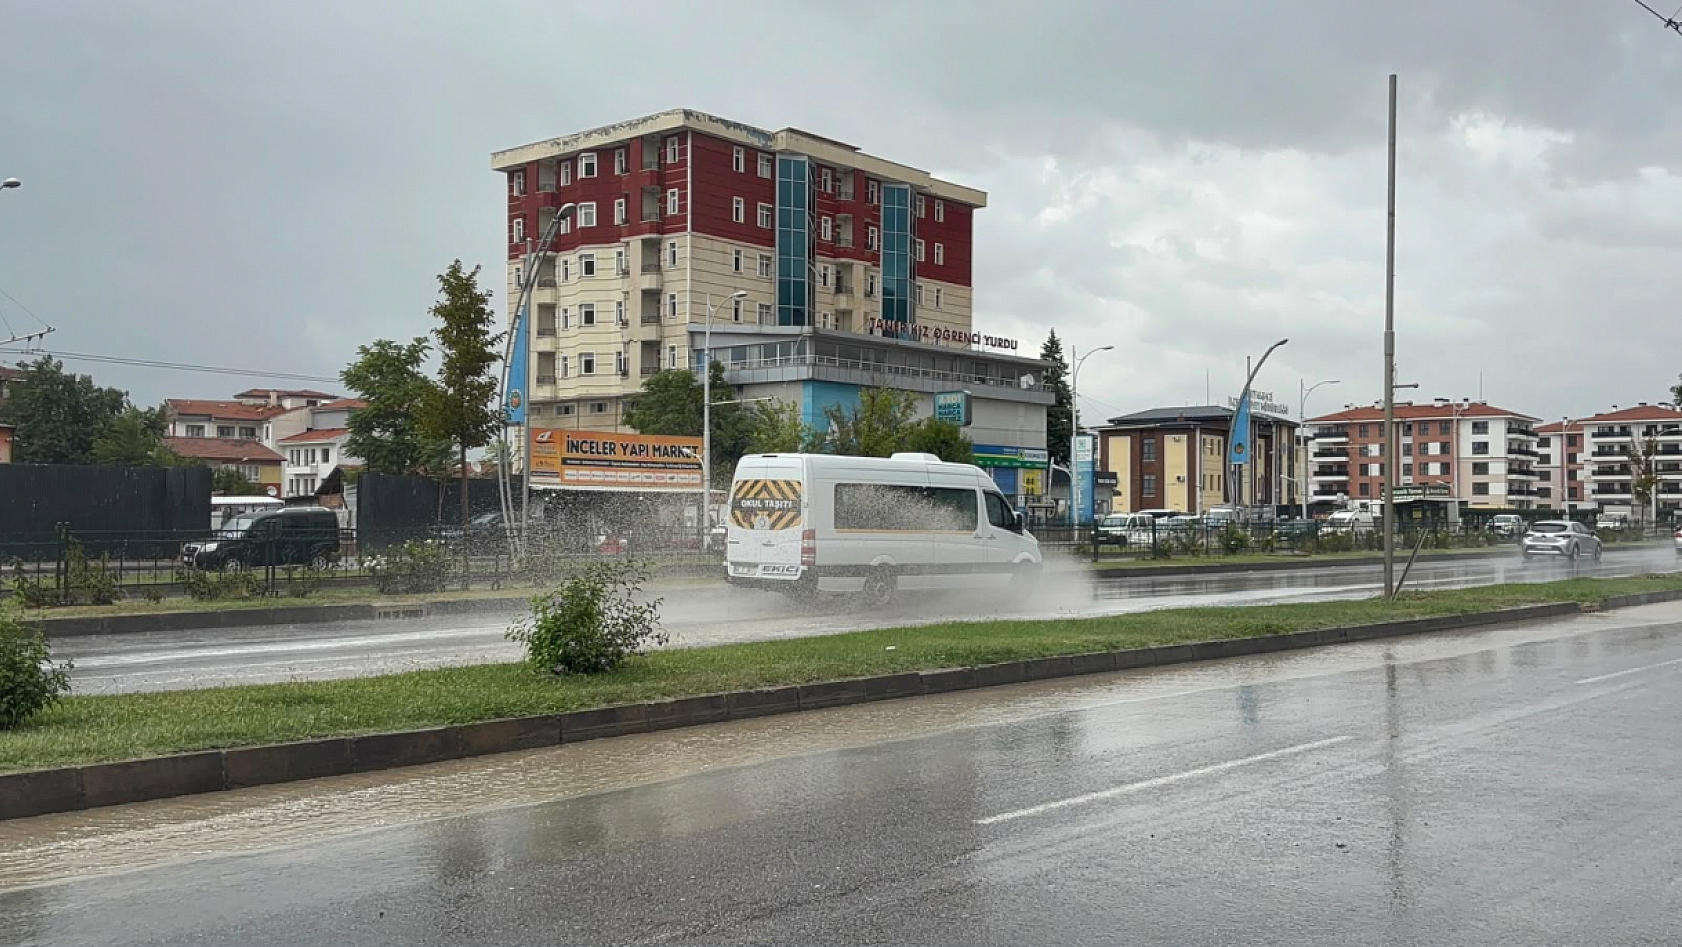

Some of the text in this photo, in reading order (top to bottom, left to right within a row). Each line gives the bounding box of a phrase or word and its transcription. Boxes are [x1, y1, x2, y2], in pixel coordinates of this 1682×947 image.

[983, 335, 1018, 350] YURDU
[566, 435, 617, 456] İNCELER
[620, 442, 649, 457] YAPI
[741, 499, 763, 508] OKUL
